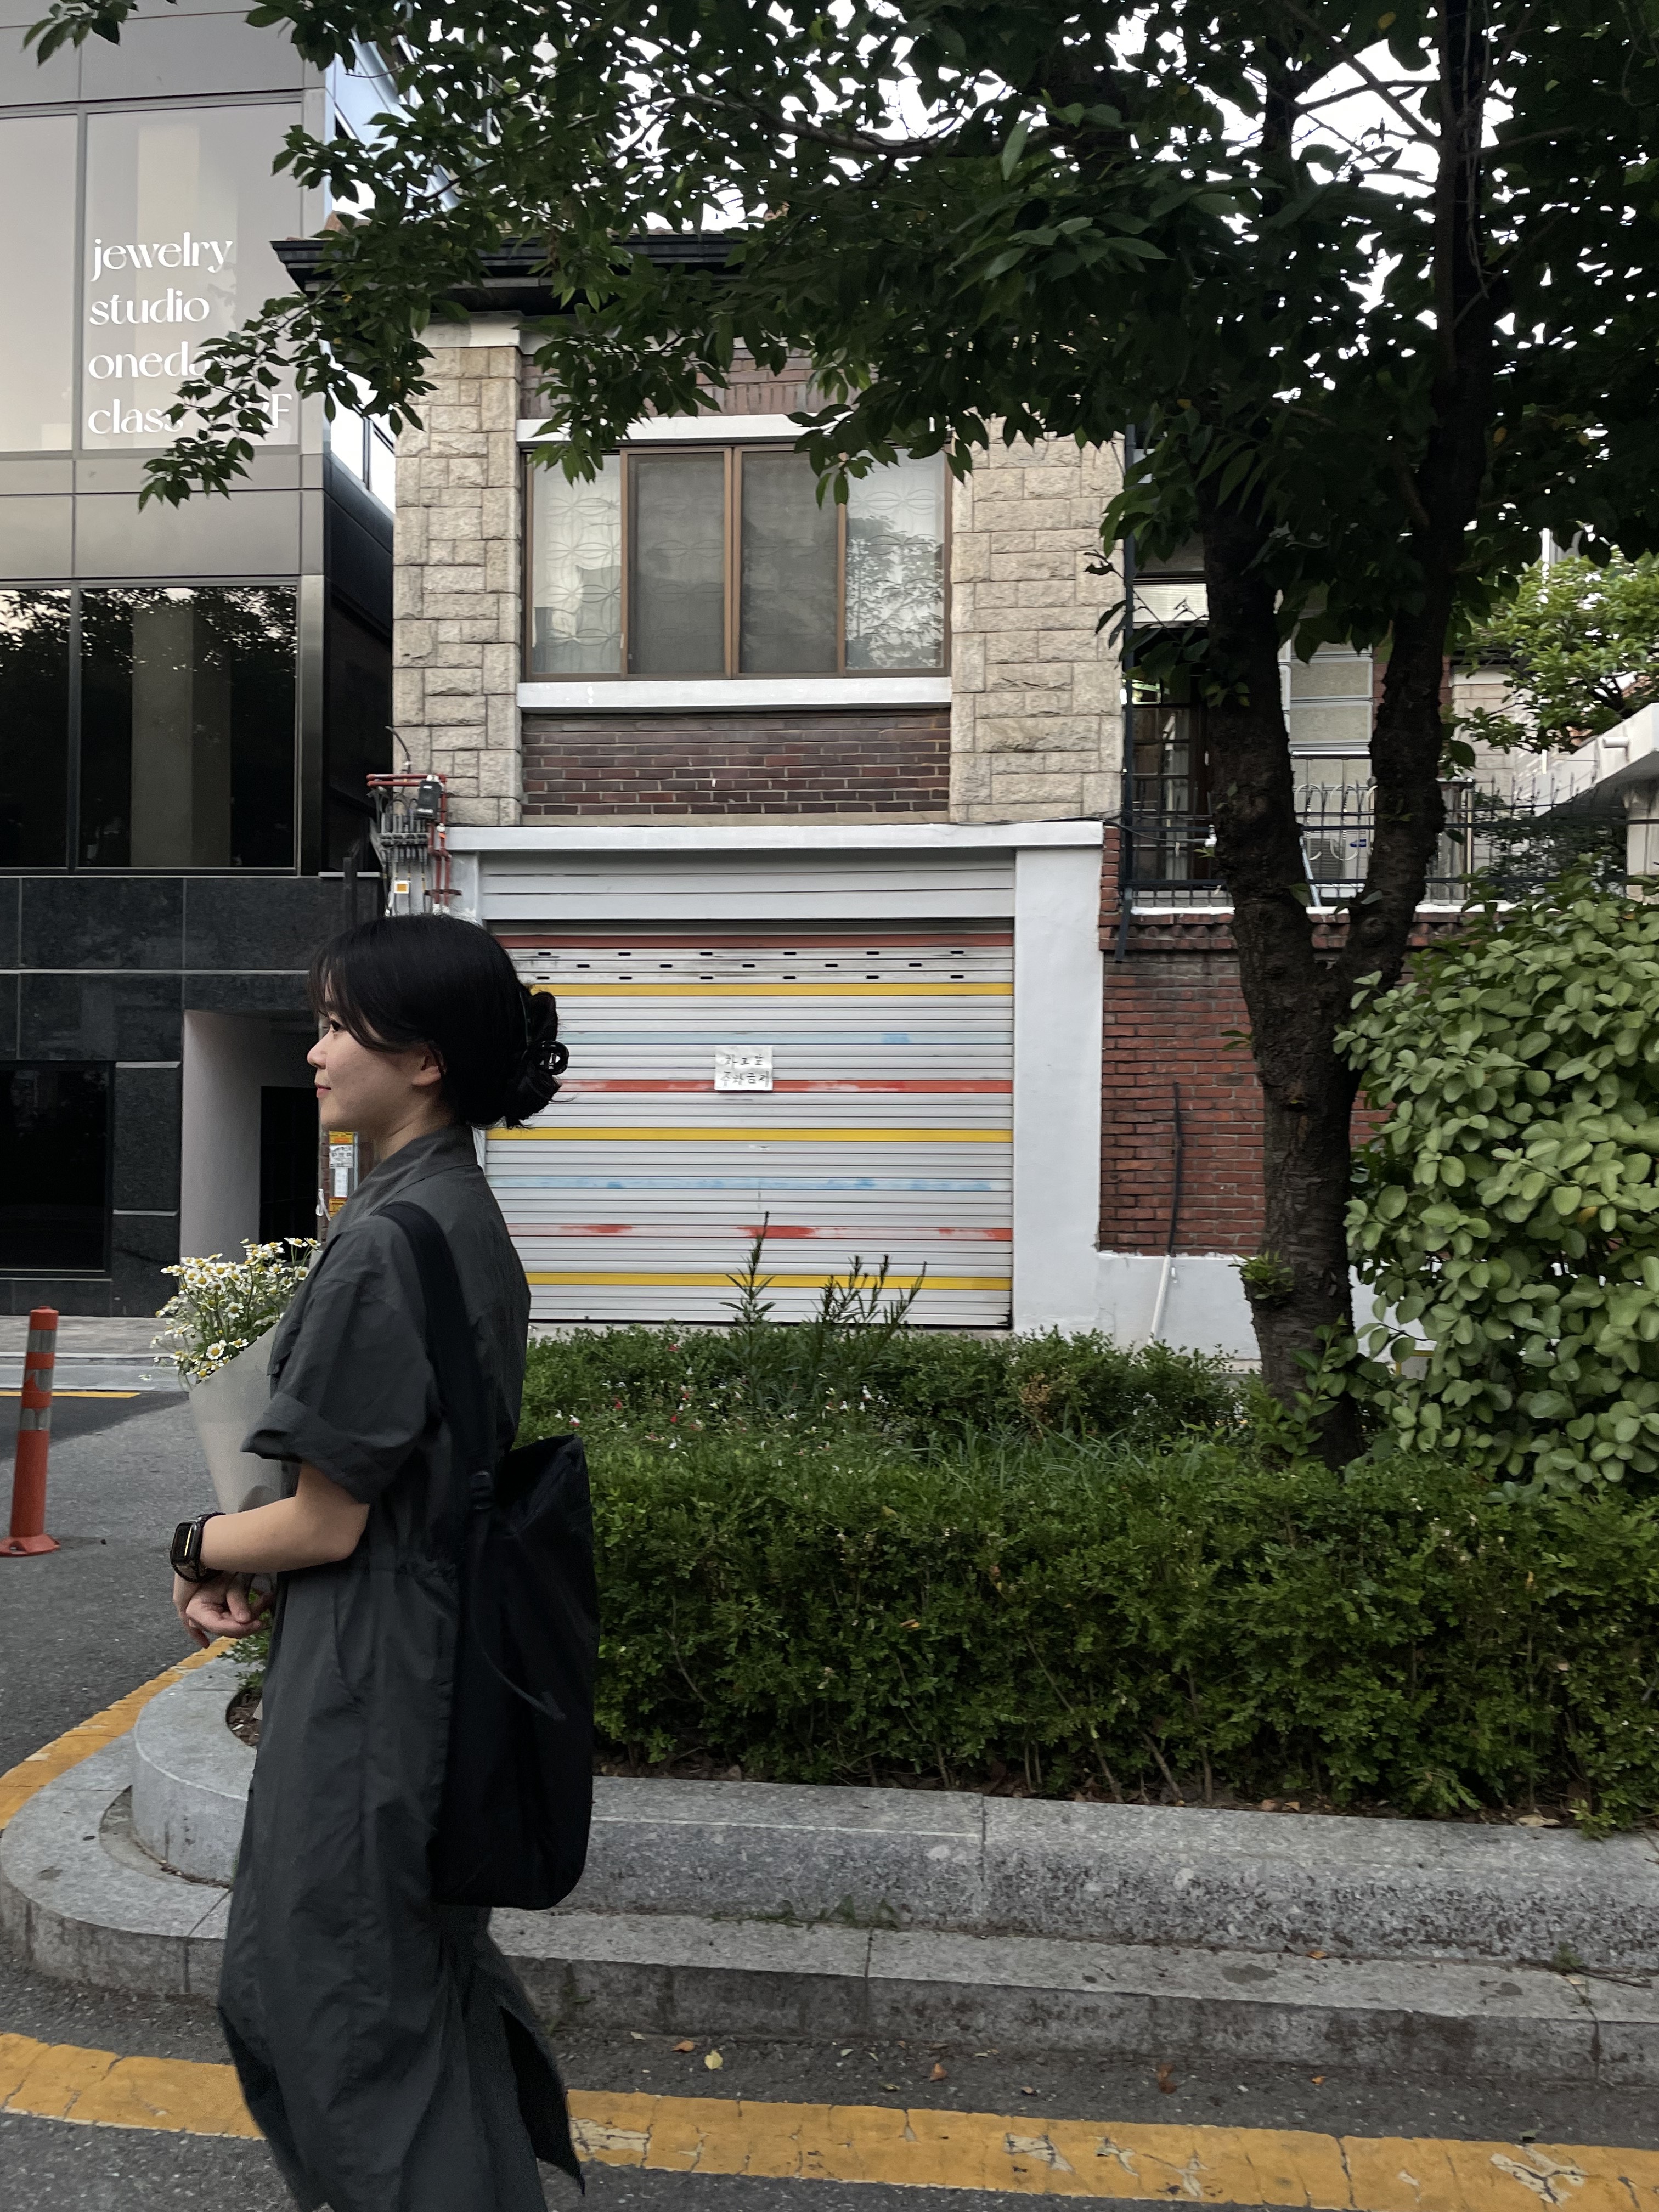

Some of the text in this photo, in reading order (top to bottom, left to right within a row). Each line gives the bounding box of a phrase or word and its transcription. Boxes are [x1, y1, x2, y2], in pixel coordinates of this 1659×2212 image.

[90, 232, 233, 282] jewelry
[89, 287, 210, 325] studio
[88, 341, 230, 380] oneda
[720, 1070, 769, 1087] 주차금지
